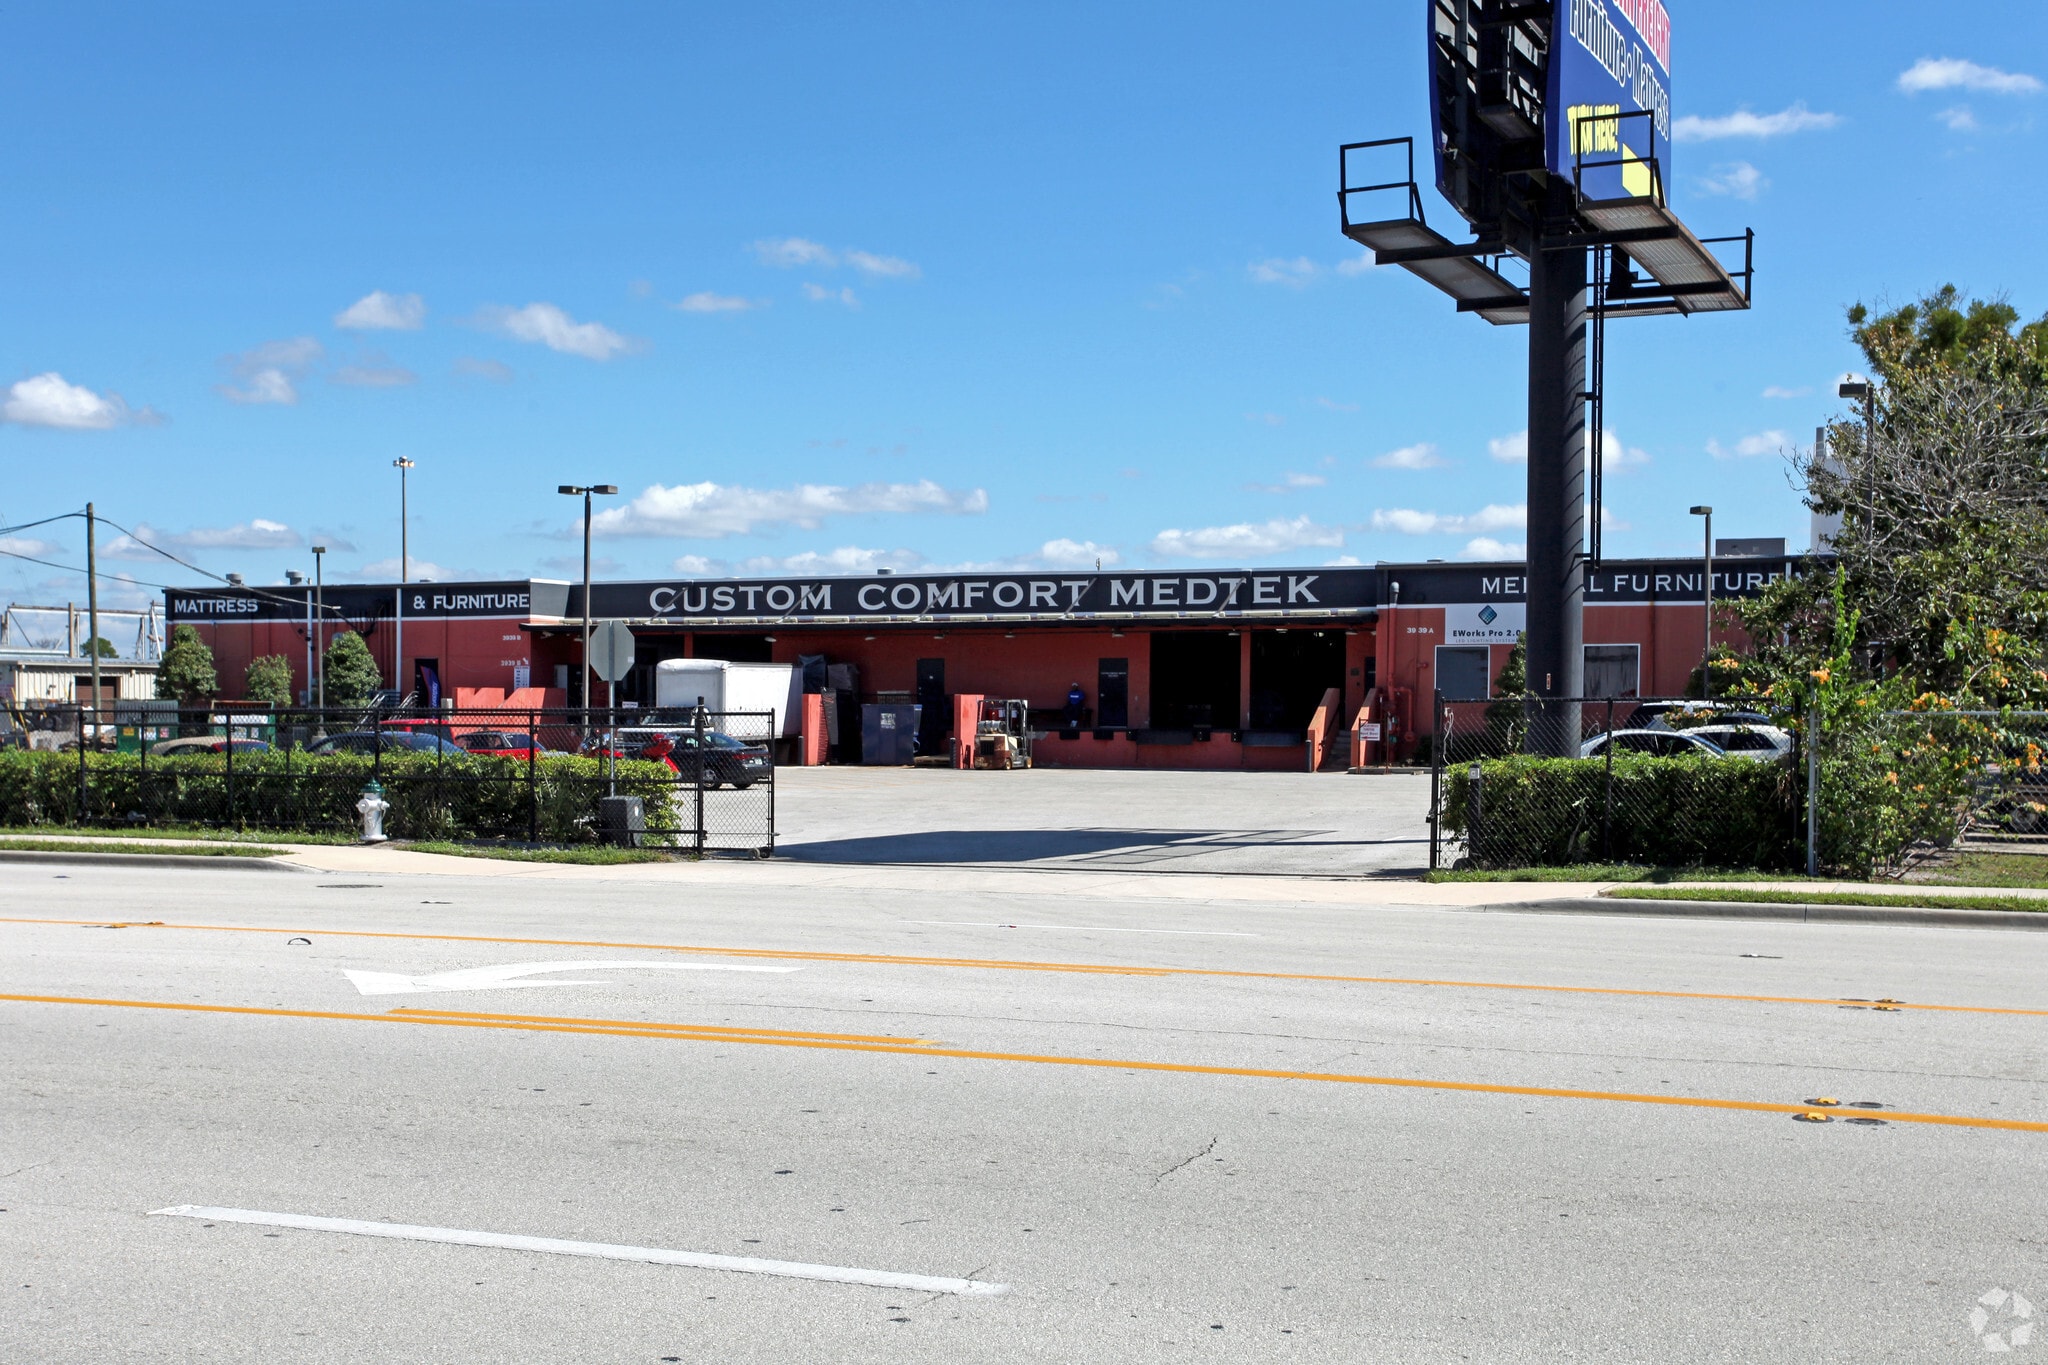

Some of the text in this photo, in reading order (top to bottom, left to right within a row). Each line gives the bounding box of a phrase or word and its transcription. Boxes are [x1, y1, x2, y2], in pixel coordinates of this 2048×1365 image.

[413, 593, 530, 610] & FURNITURE
[650, 575, 1320, 613] CUSTOM COMFORT MEDTEK
[174, 599, 258, 613] MATTRESS
[1452, 629, 1521, 637] EWorks Pro 2.0
